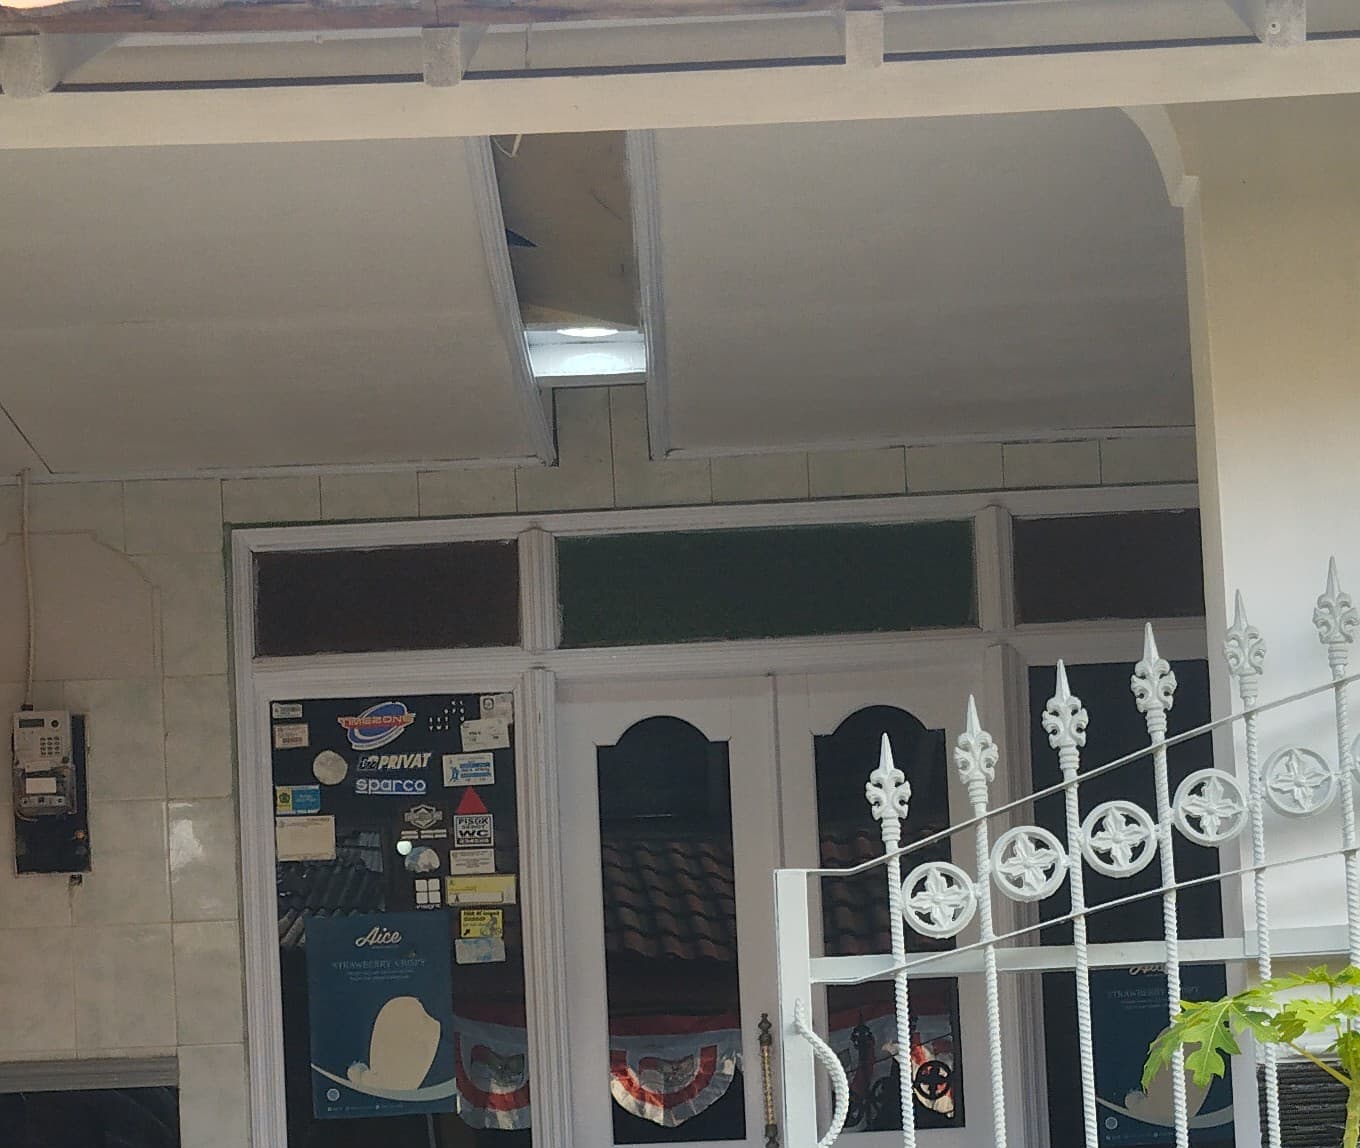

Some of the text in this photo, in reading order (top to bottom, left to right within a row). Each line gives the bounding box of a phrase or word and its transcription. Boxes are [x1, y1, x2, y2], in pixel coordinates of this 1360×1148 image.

[377, 752, 432, 770] PRIVAT
[355, 777, 427, 795] sparco
[458, 829, 489, 837] WC
[354, 926, 403, 948] Aice
